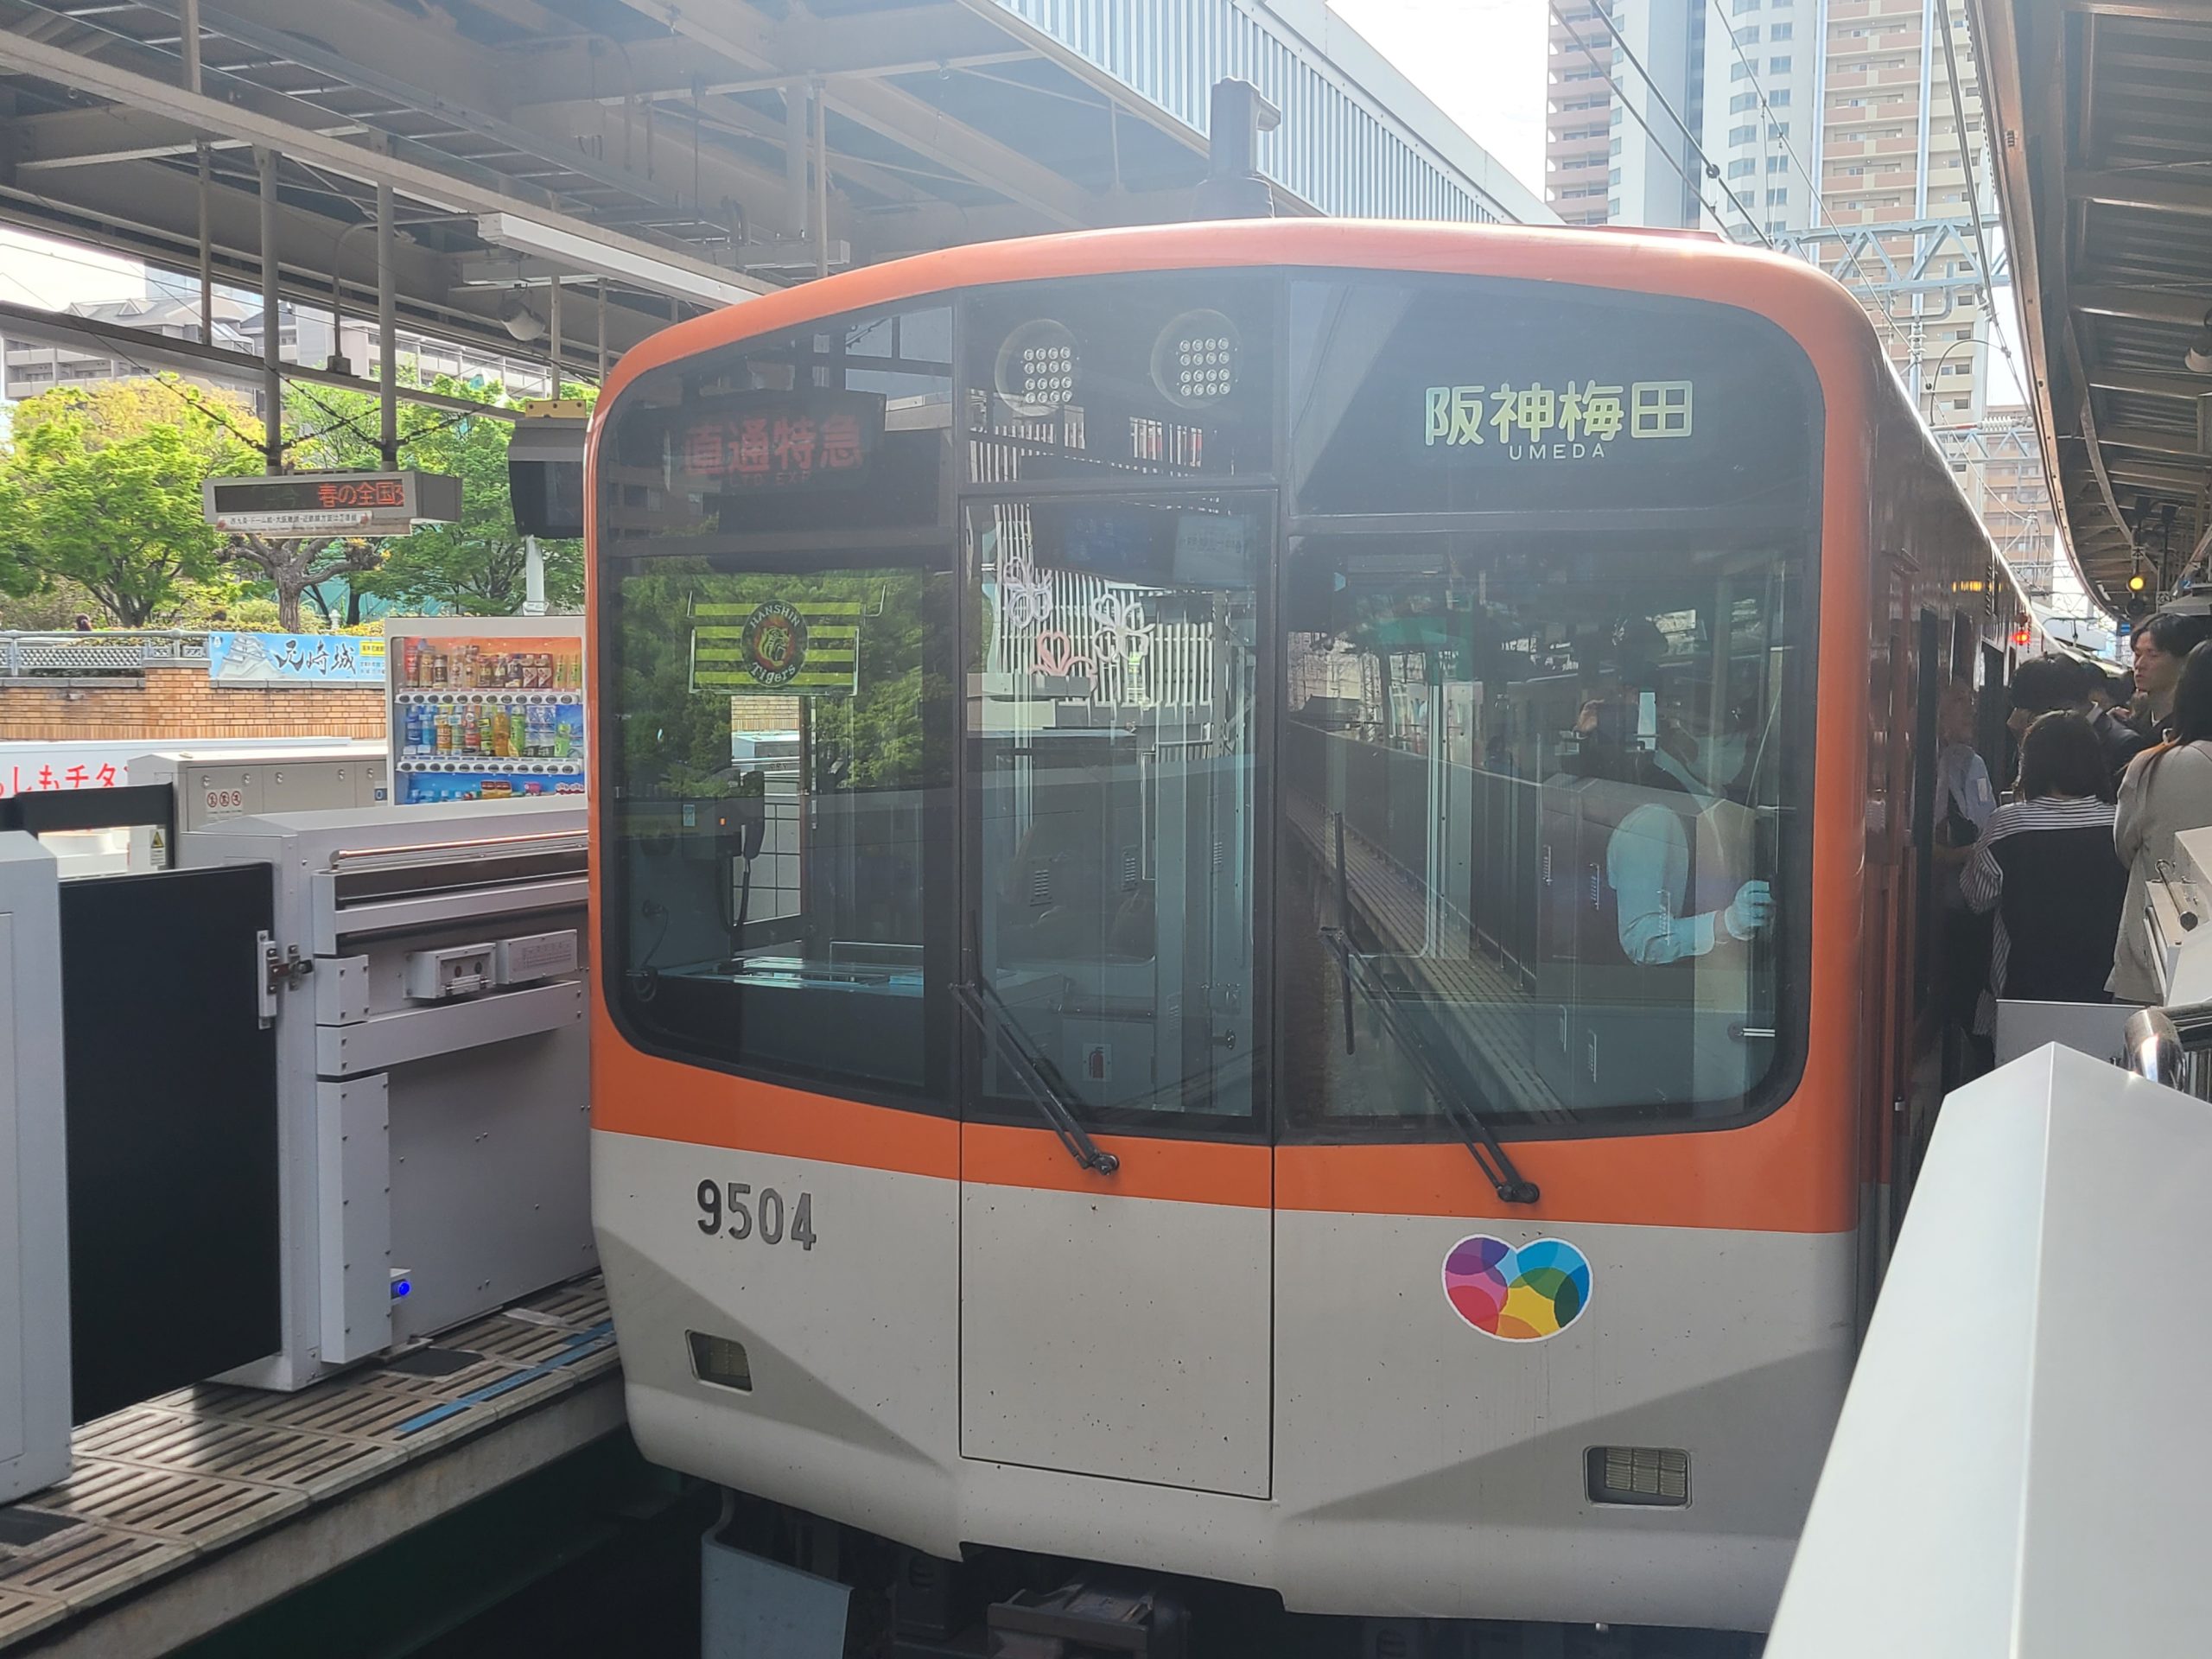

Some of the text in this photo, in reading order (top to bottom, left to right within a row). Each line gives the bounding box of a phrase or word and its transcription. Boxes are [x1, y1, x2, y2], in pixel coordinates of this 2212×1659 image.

[1426, 379, 1693, 446] 阪神梅田
[685, 415, 862, 474] 直通特急
[1509, 442, 1605, 461] UMEDA
[750, 604, 801, 628] HANSHIN
[274, 639, 356, 676] 尼崎城
[751, 662, 796, 684] Tigers
[697, 1179, 817, 1251] 9504
